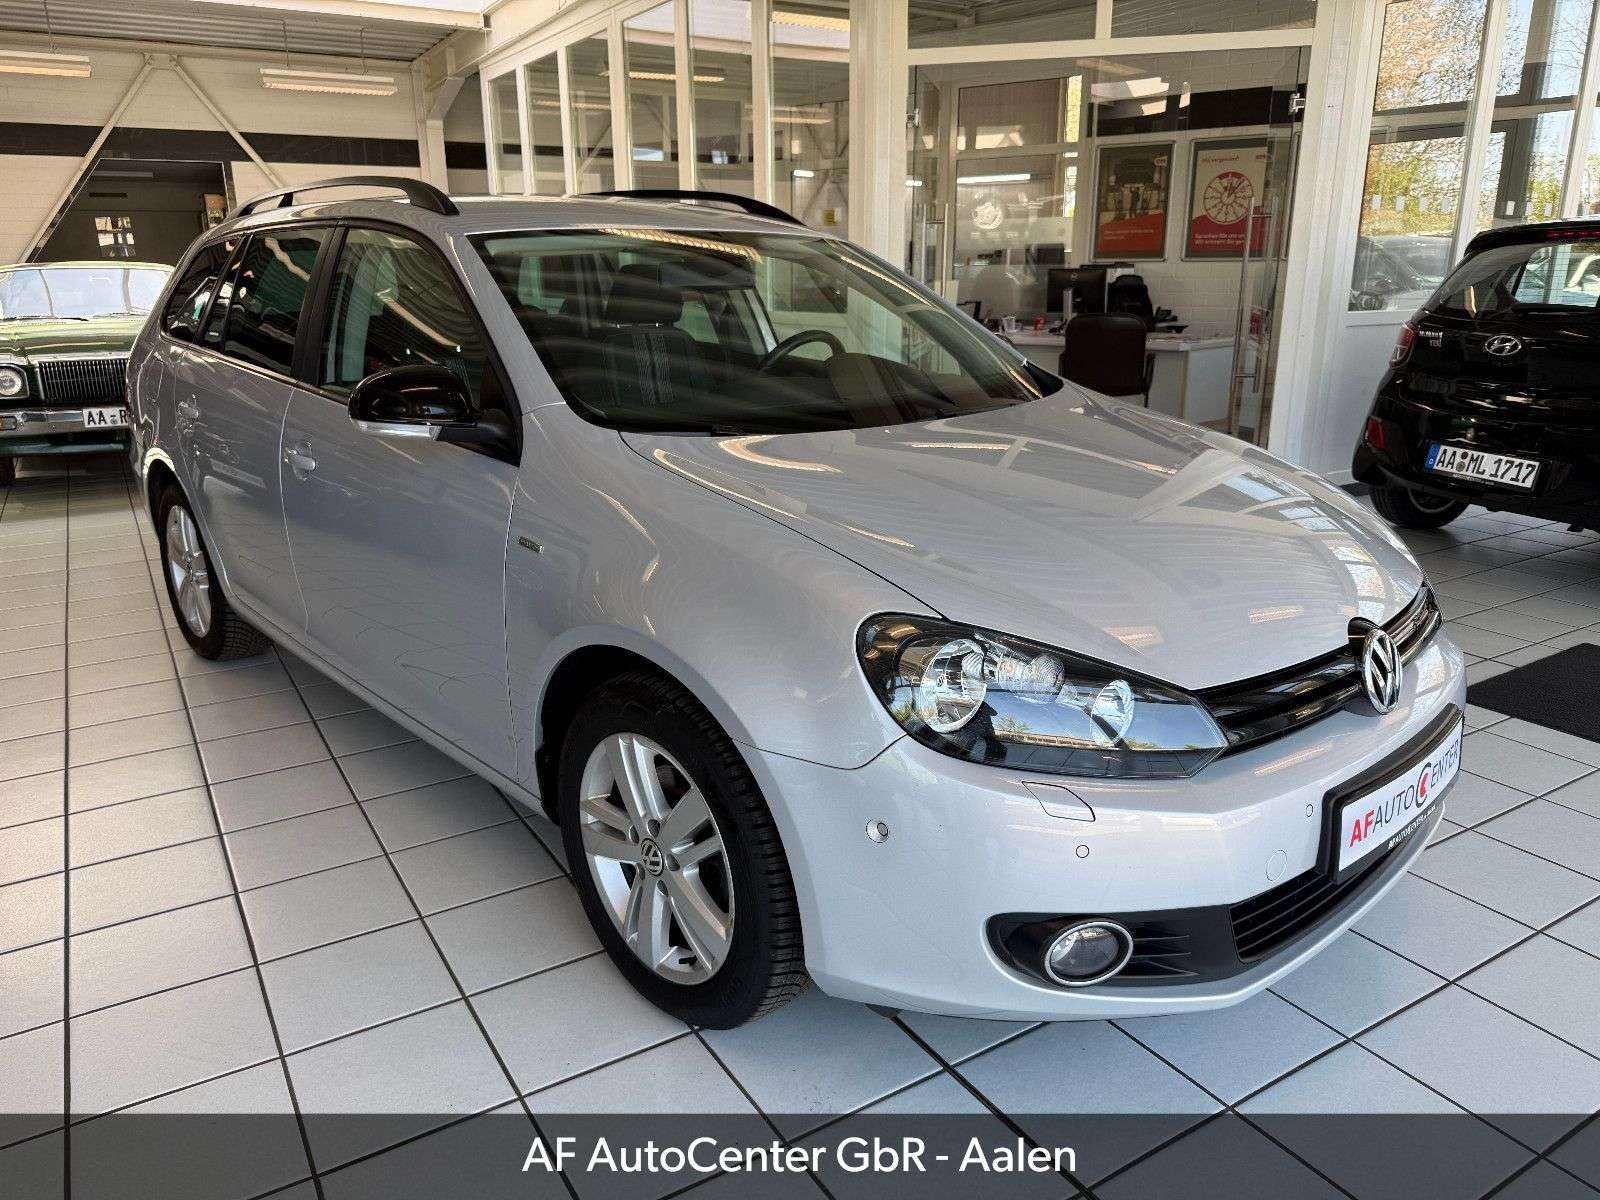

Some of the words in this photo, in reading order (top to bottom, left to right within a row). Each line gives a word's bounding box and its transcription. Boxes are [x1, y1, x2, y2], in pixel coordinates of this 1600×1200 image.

[1436, 448, 1457, 469] AA
[1466, 453, 1486, 475] ML
[1489, 458, 1537, 484] 1717
